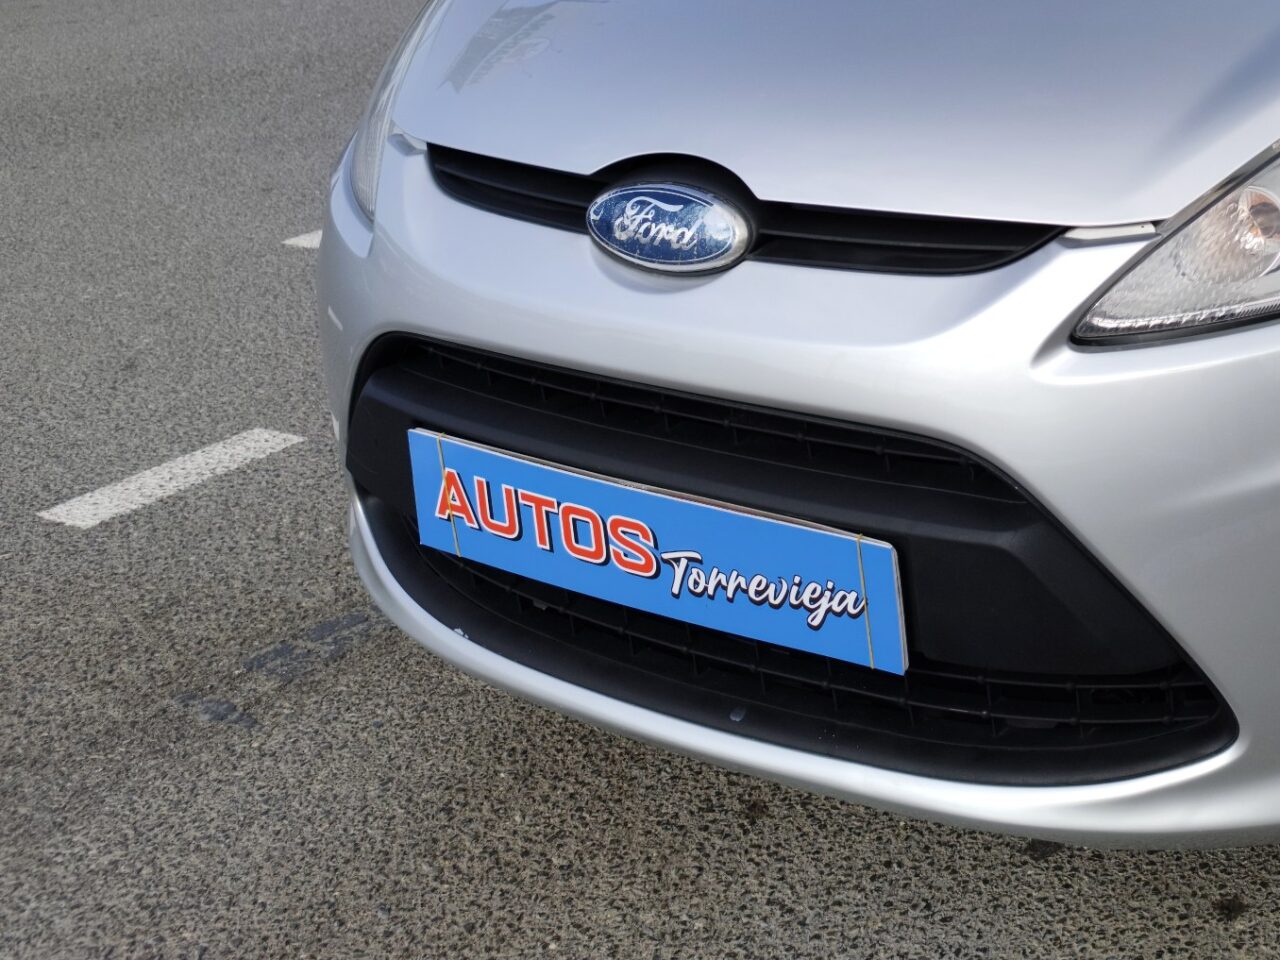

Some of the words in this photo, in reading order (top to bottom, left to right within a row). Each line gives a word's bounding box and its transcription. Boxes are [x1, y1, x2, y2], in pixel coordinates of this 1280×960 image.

[614, 195, 702, 251] Ford
[434, 467, 660, 580] AUTOS
[661, 550, 870, 630] Torrevieja
